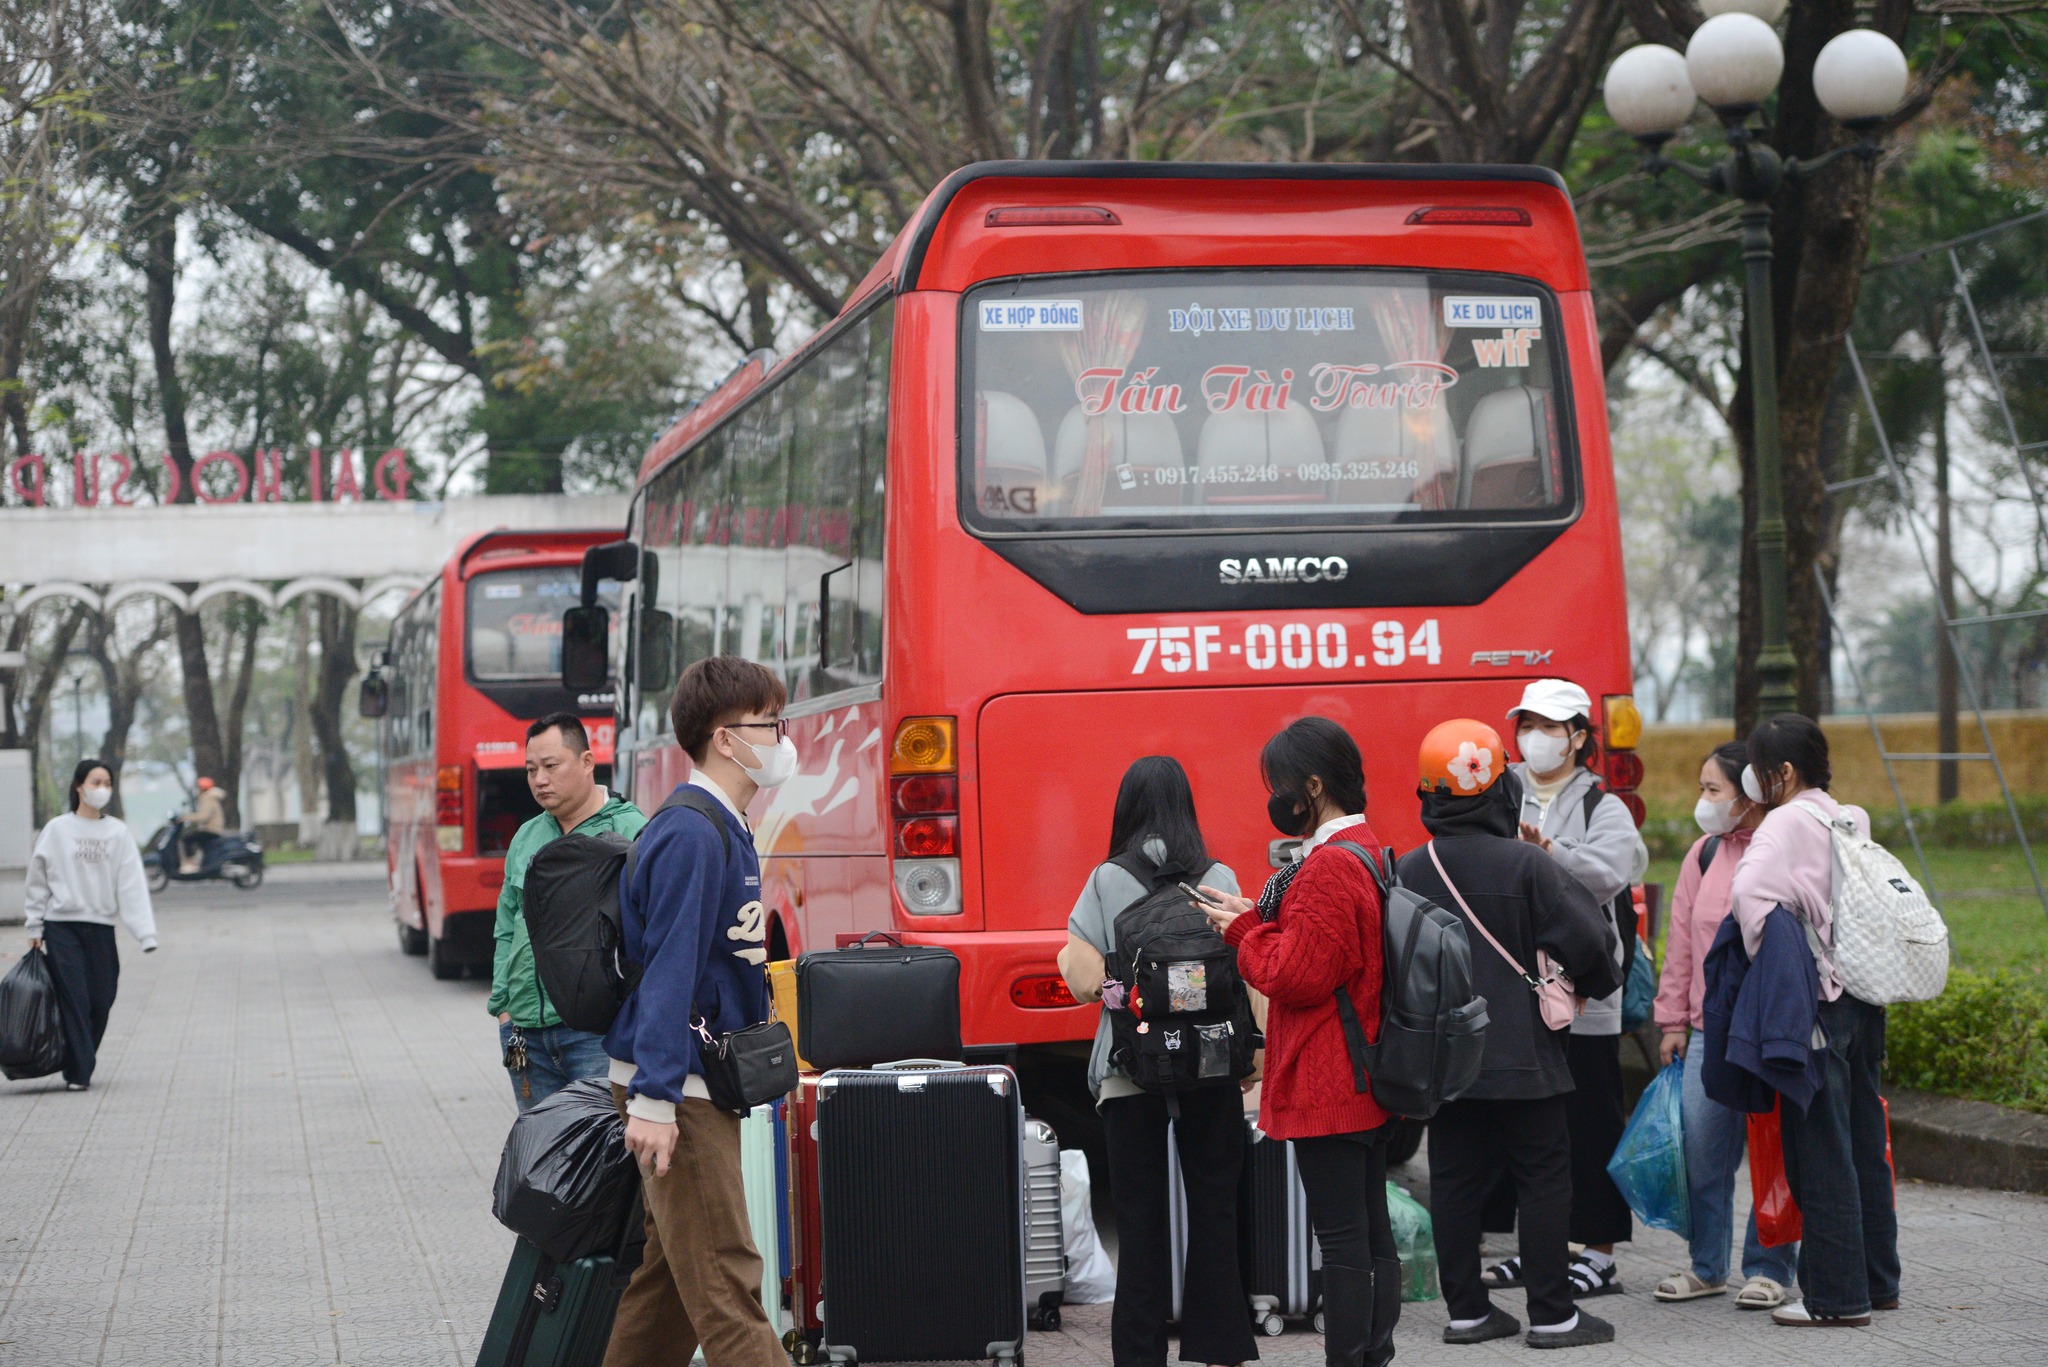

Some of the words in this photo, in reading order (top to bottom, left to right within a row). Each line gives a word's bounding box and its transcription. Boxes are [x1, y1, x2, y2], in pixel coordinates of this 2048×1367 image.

[985, 307, 1003, 324] XE
[1007, 305, 1036, 328] HỢP
[1040, 302, 1079, 324] ĐỒNG
[1168, 303, 1215, 337] ĐỘI
[1218, 308, 1251, 331] XE
[1255, 308, 1291, 331] DU
[1295, 307, 1355, 335] LỊCH
[1452, 304, 1471, 320] XE
[1476, 304, 1495, 320] DU
[1501, 304, 1533, 324] LỊCH
[1075, 367, 1187, 416] Tấn
[1201, 365, 1295, 414] Tài
[1308, 360, 1460, 412] Tourist
[1154, 464, 1279, 486] 0917.455.246
[1297, 460, 1420, 483] 0935.325.246
[1219, 556, 1349, 585] SAMCO
[1127, 619, 1442, 675] 75F-000.94
